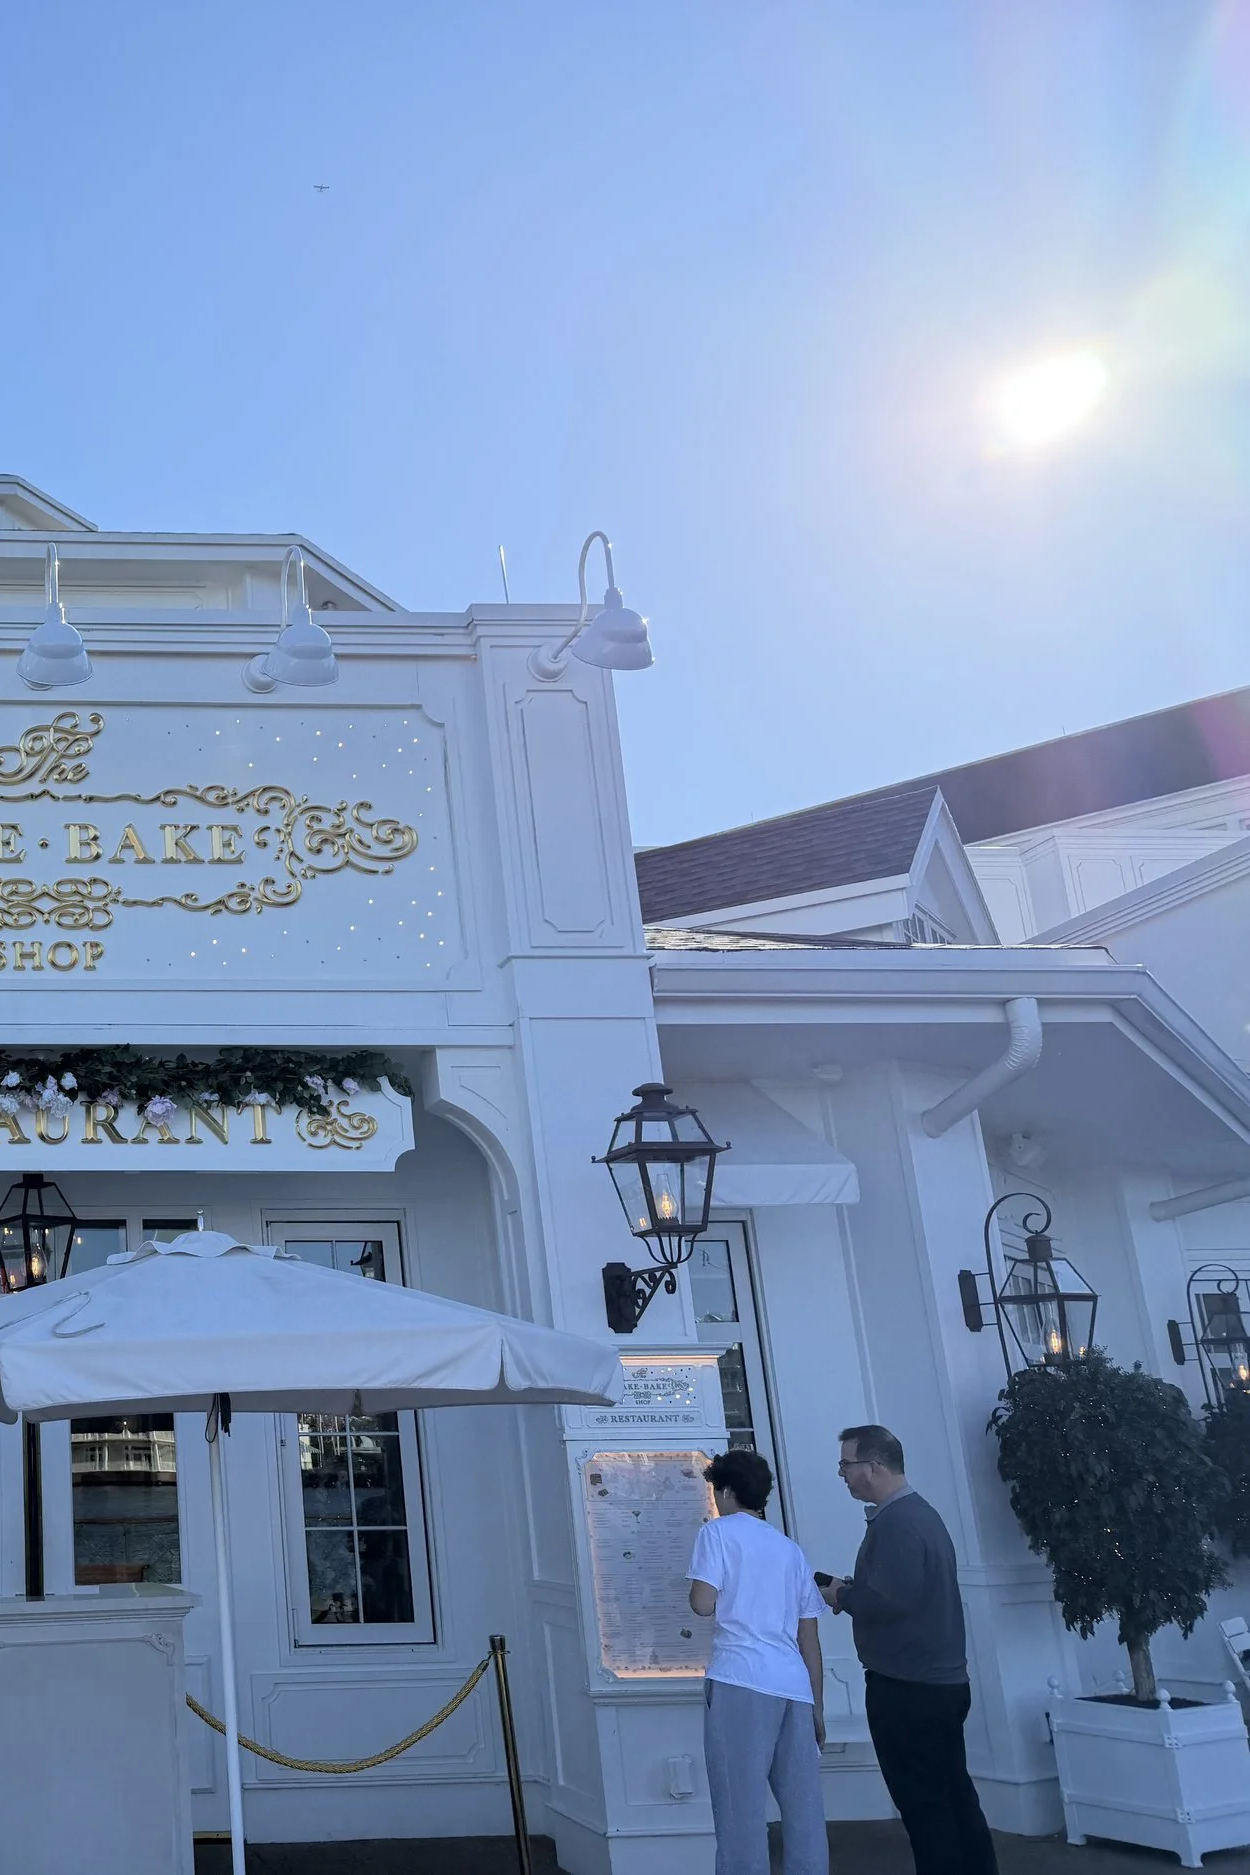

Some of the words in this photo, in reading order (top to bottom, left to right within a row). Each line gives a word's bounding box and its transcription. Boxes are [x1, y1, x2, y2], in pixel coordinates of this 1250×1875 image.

[63, 822, 247, 865] BAKE
[632, 1367, 648, 1379] The
[610, 1414, 680, 1424] RESTAURANT
